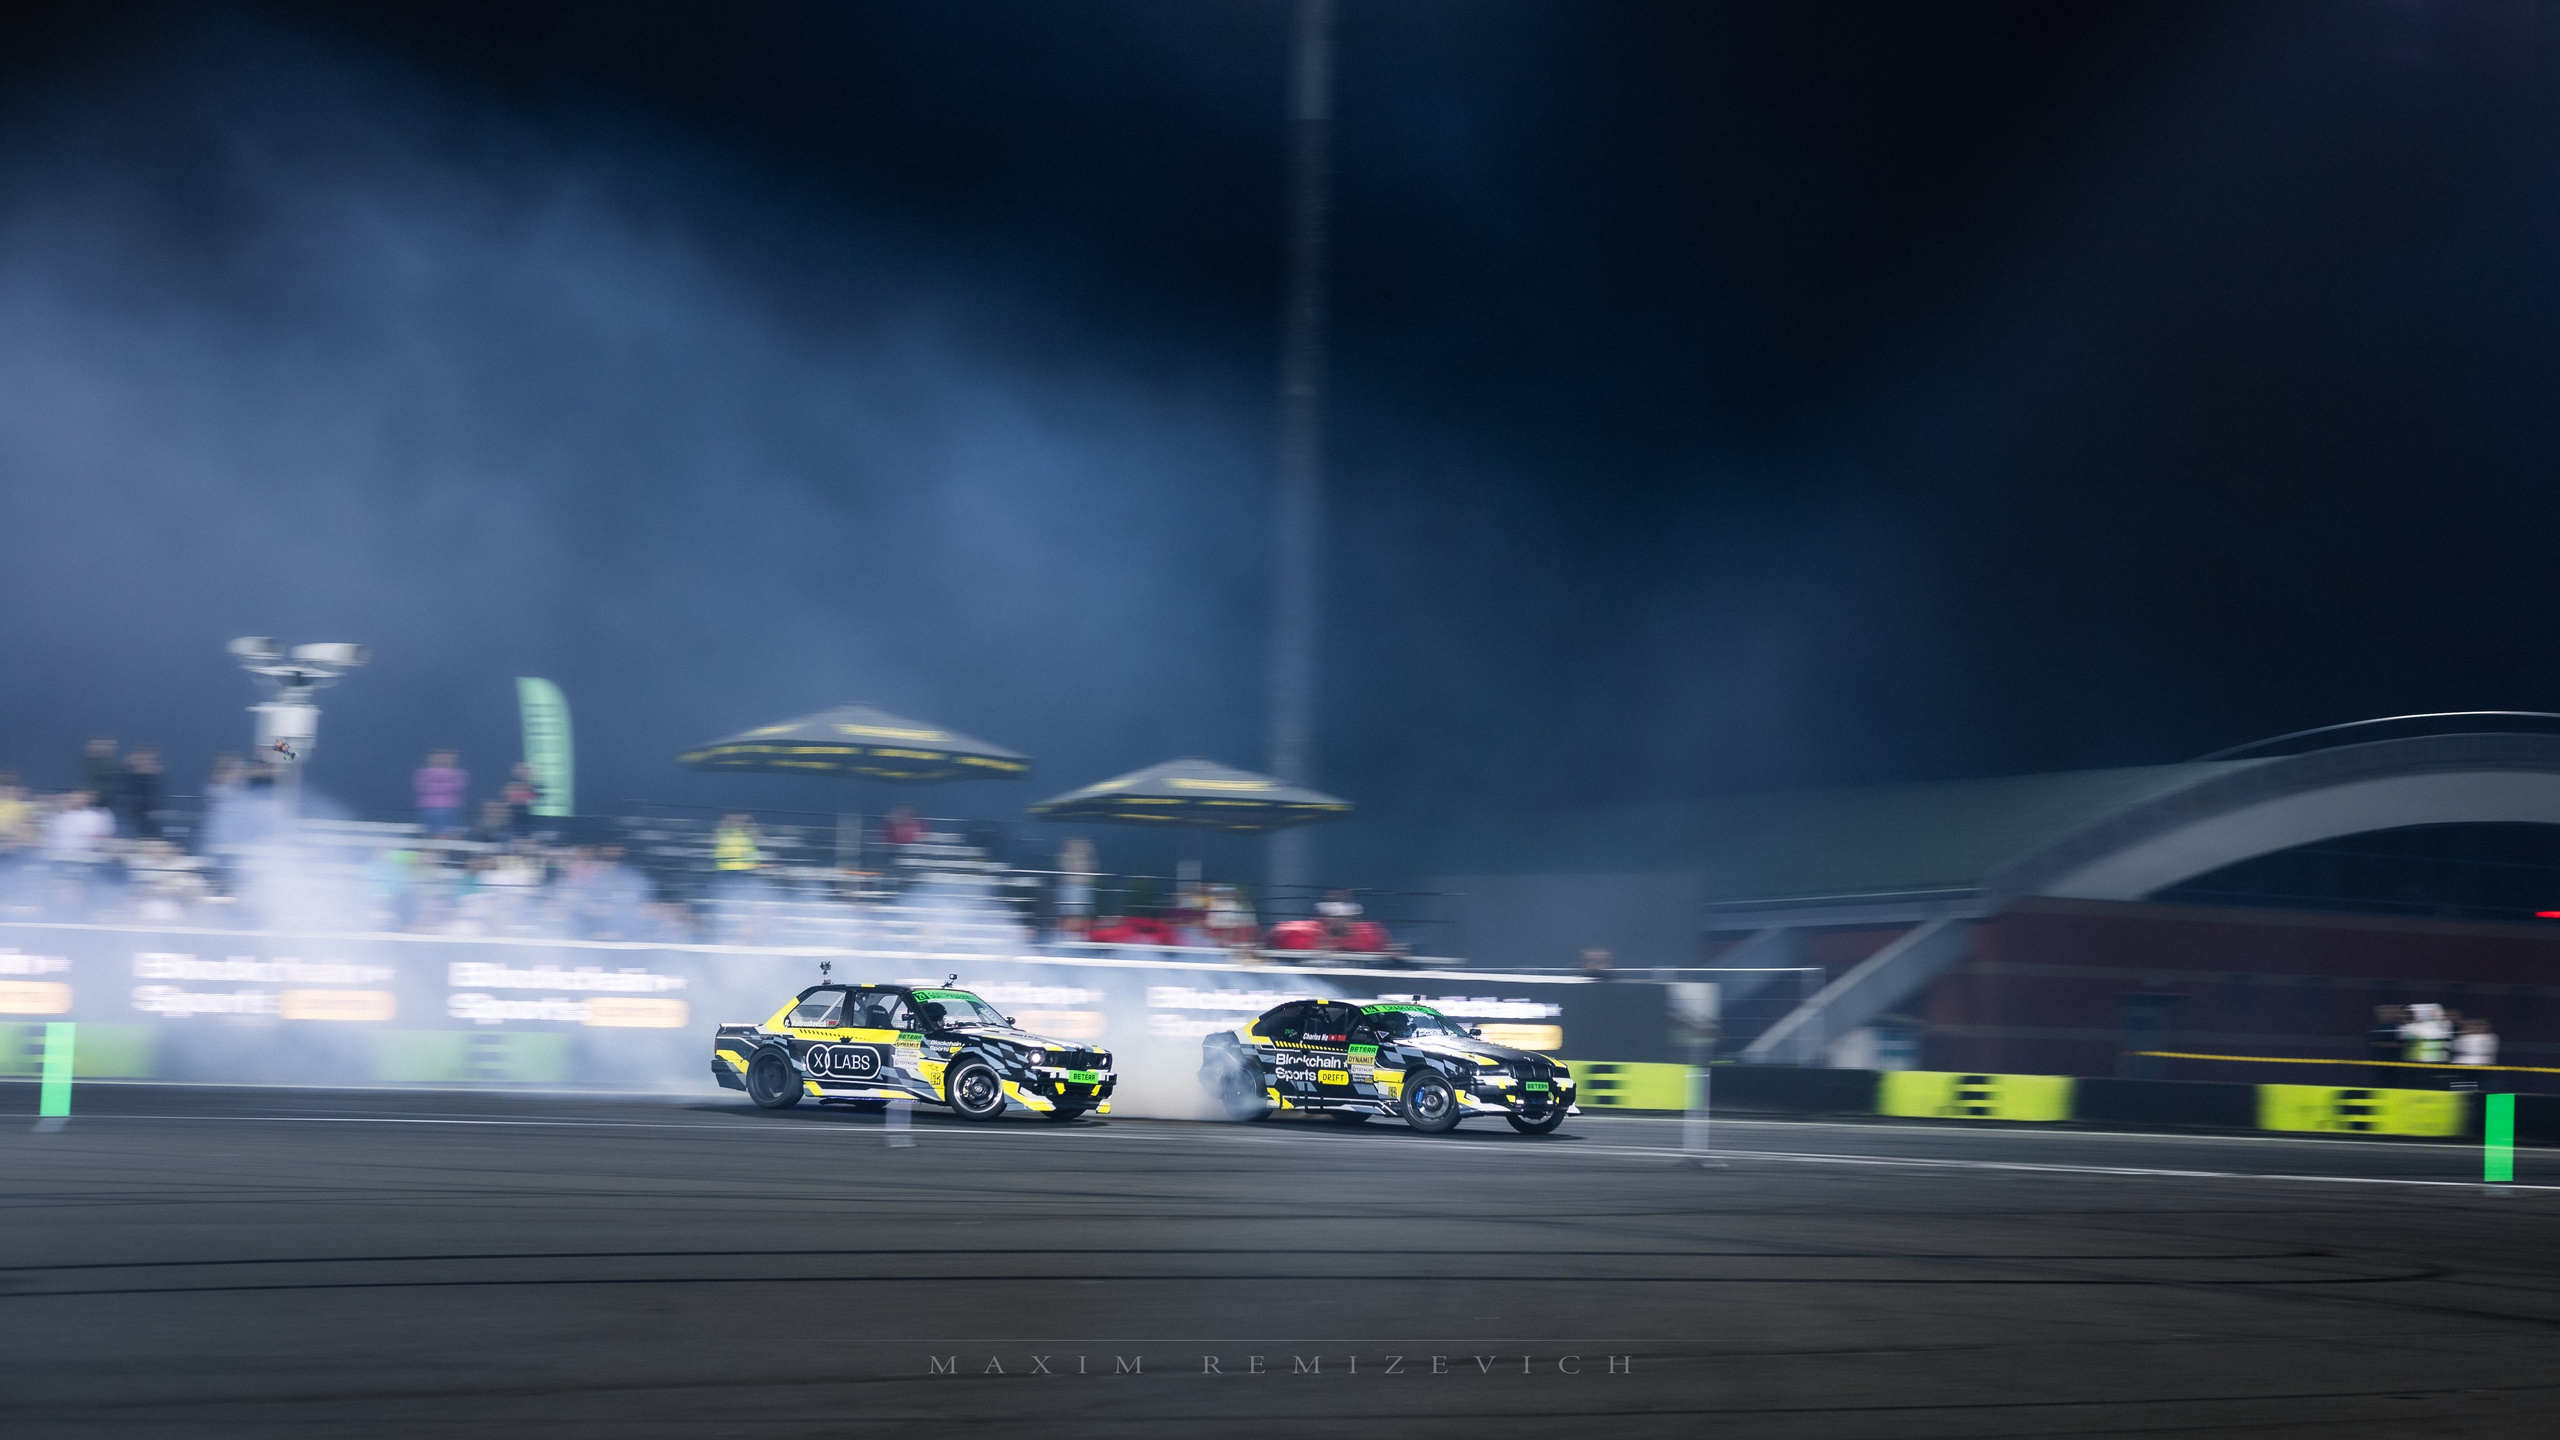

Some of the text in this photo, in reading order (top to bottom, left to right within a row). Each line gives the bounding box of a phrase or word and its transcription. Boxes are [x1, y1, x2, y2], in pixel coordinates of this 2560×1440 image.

[1303, 1033, 1321, 1041] Charles
[813, 1053, 870, 1070] X LABS
[1073, 1073, 1096, 1081] BETERA
[1275, 1067, 1345, 1082] Sports DRIFT
